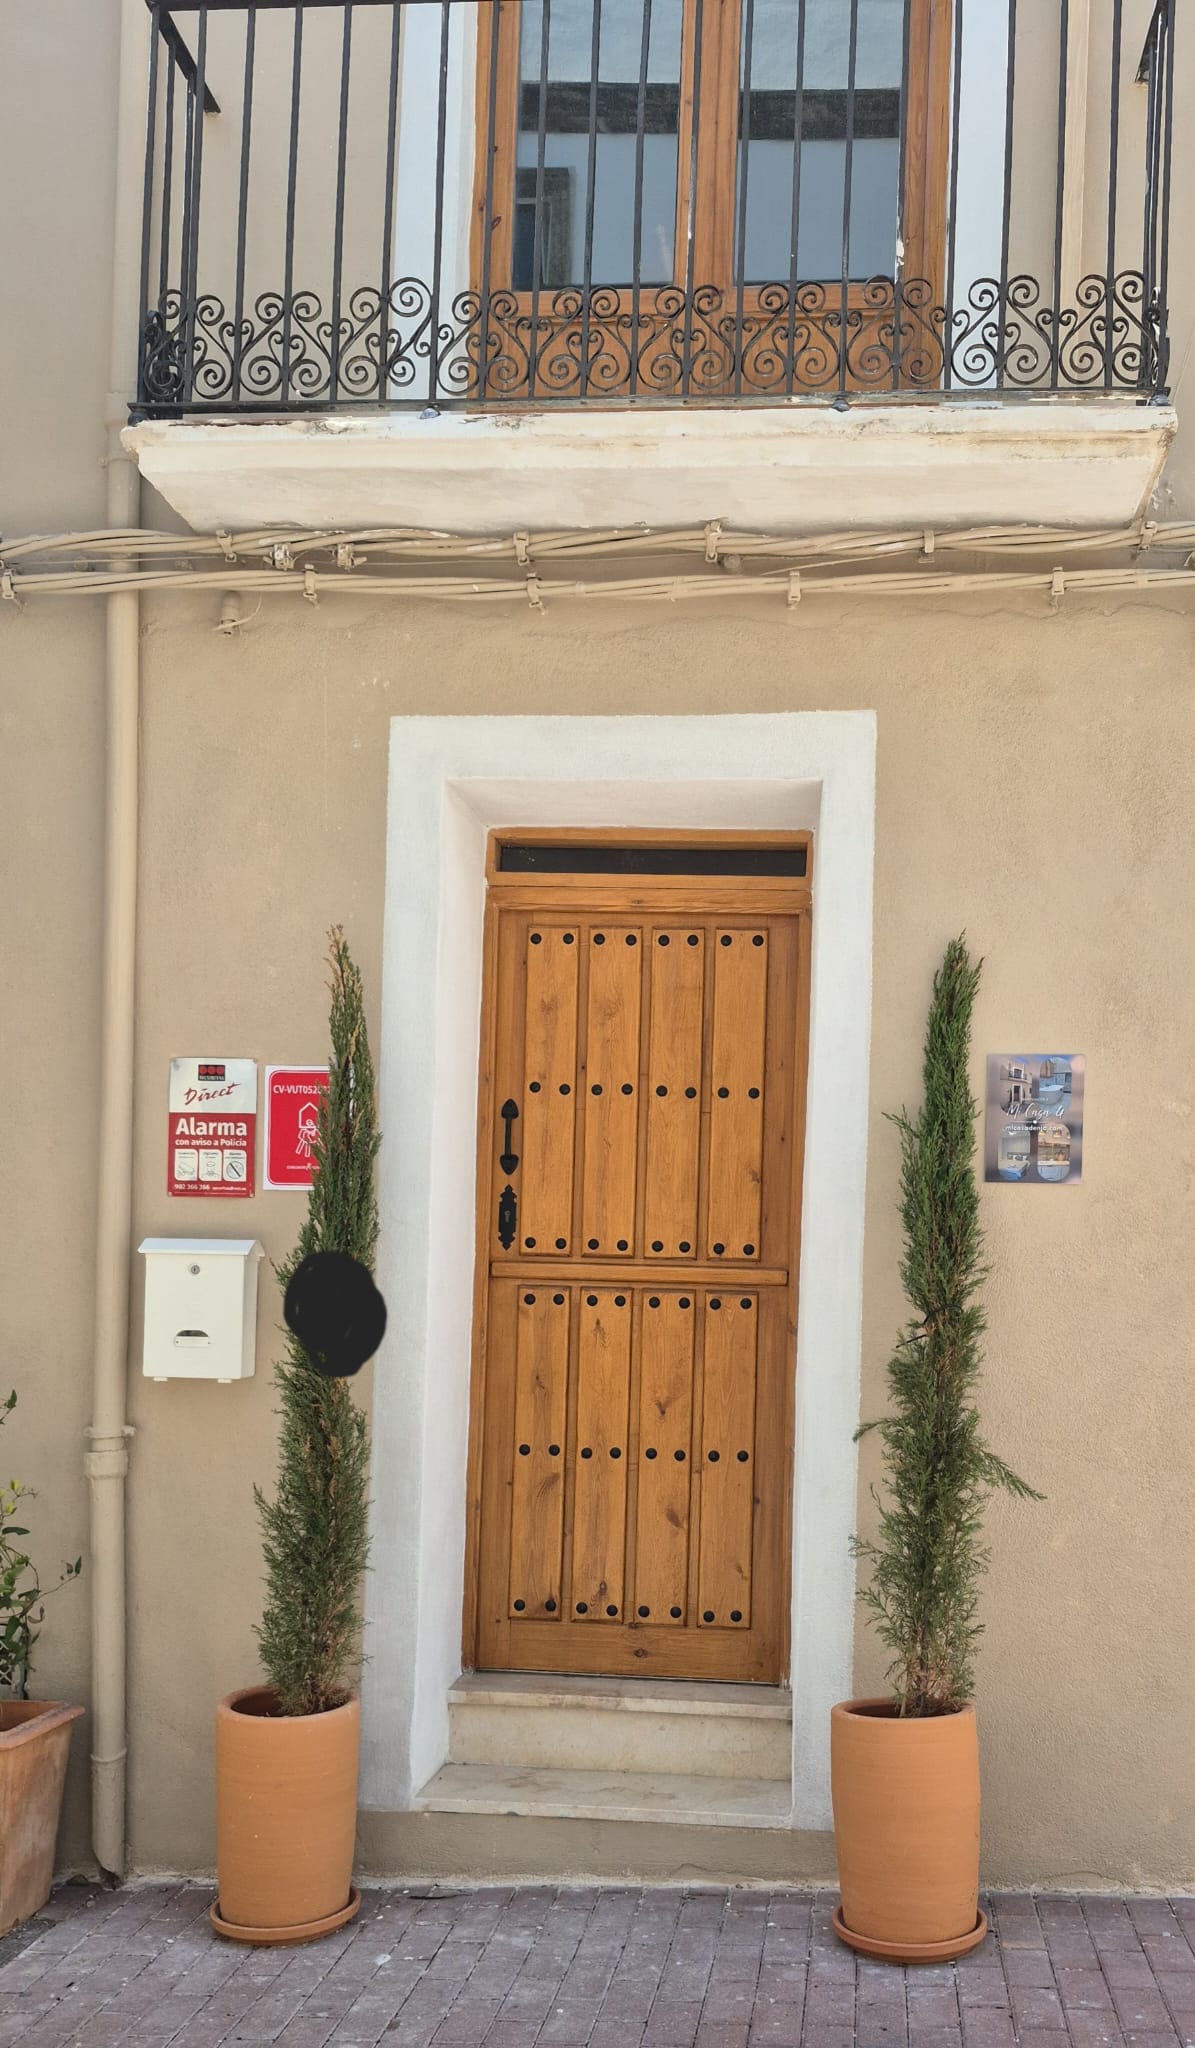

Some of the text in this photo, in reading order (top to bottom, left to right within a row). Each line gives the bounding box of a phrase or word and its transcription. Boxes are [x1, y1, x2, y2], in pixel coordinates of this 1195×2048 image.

[184, 1083, 240, 1105] Direct
[1006, 1103, 1021, 1120] Mi
[175, 1117, 247, 1136] Alarma
[191, 1138, 212, 1146] aviso
